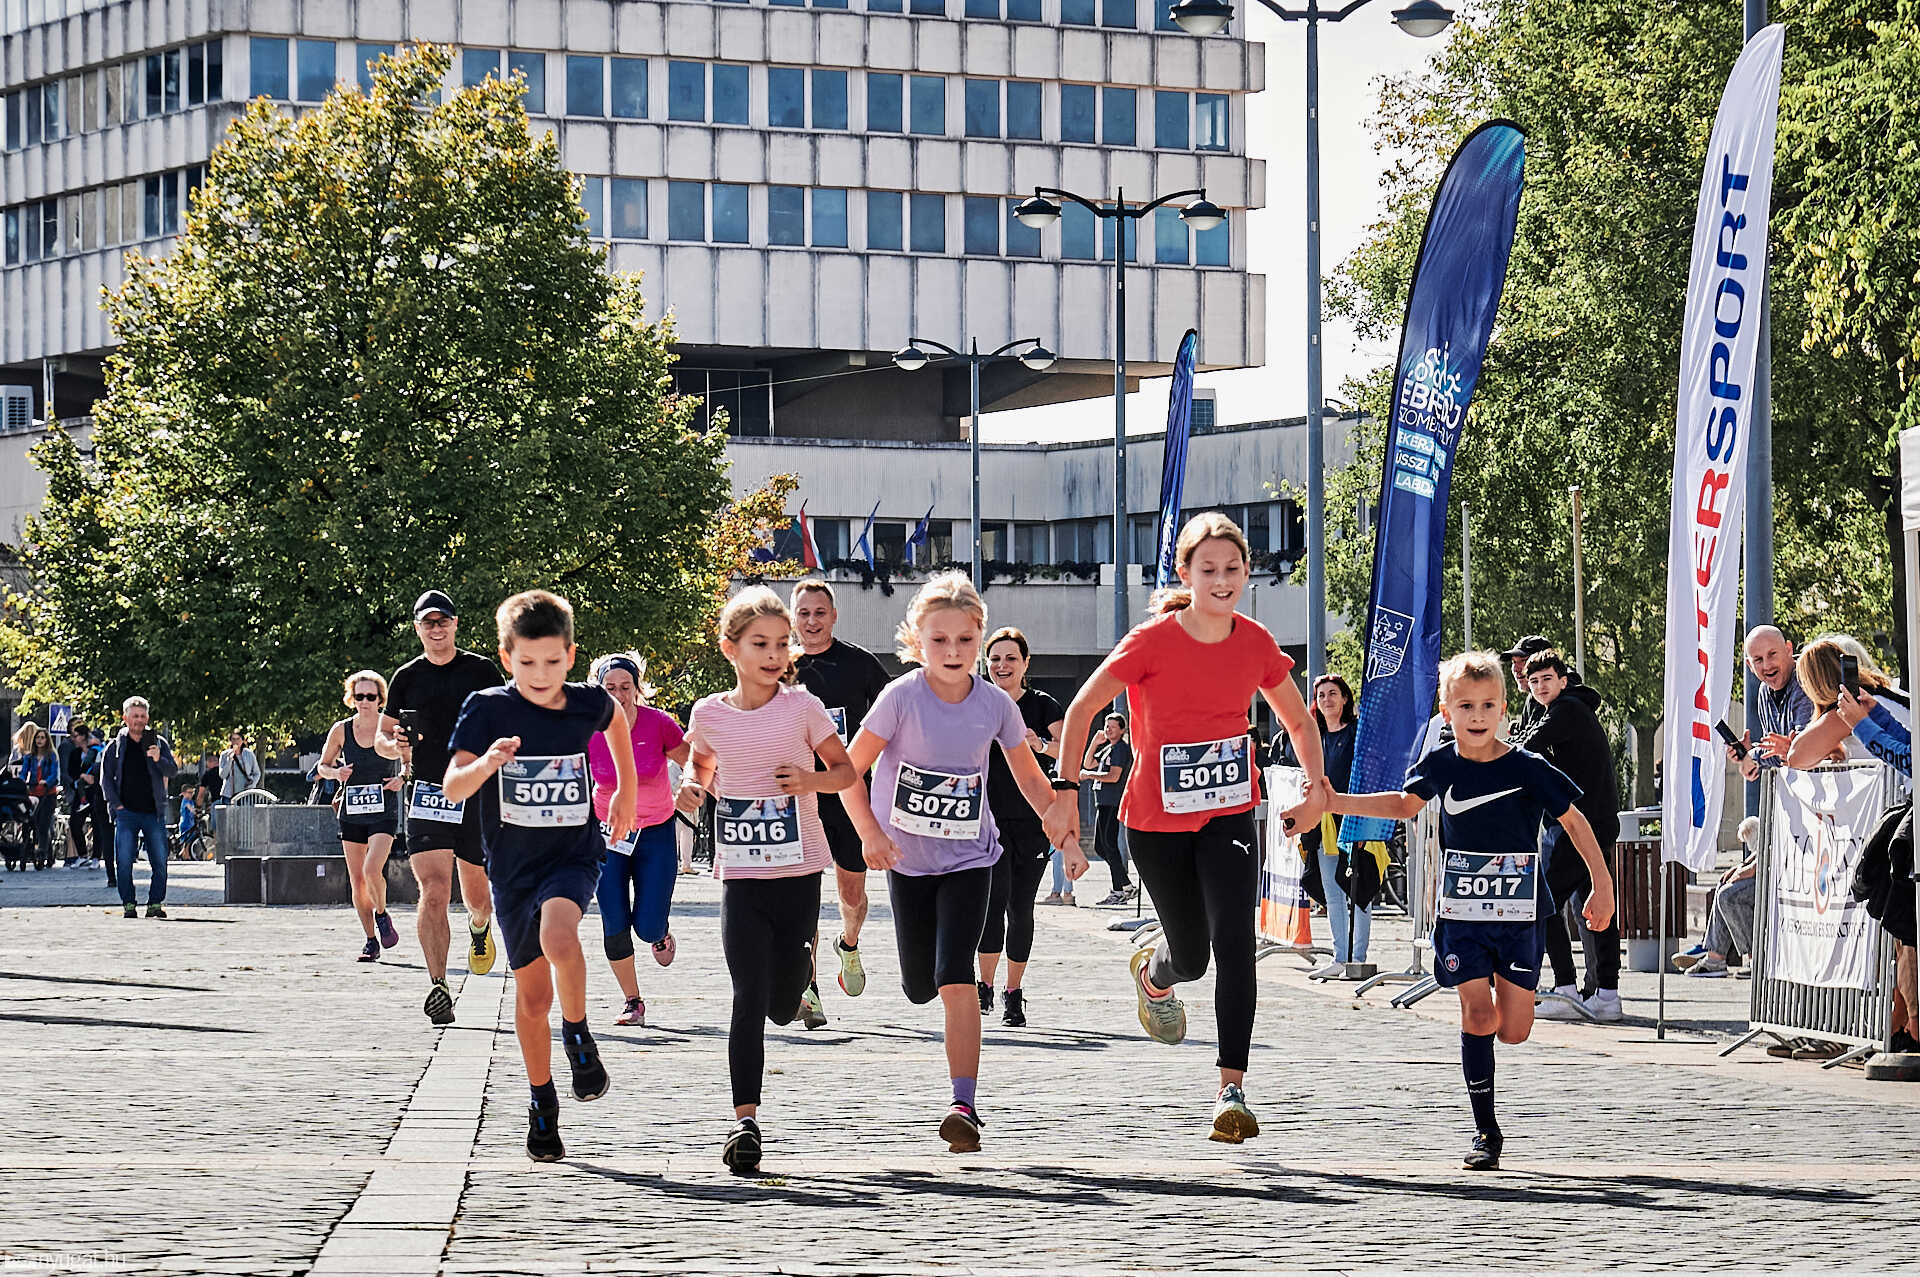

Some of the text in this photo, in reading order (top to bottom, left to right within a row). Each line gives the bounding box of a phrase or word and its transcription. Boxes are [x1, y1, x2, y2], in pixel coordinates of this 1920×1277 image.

[1691, 153, 1750, 742] INTERSPORT
[1178, 762, 1239, 789] 5019
[352, 795, 378, 805] 5112
[514, 781, 580, 803] 5076
[907, 792, 971, 818] 5078
[724, 821, 786, 842] 5016
[1456, 876, 1522, 896] 5017
